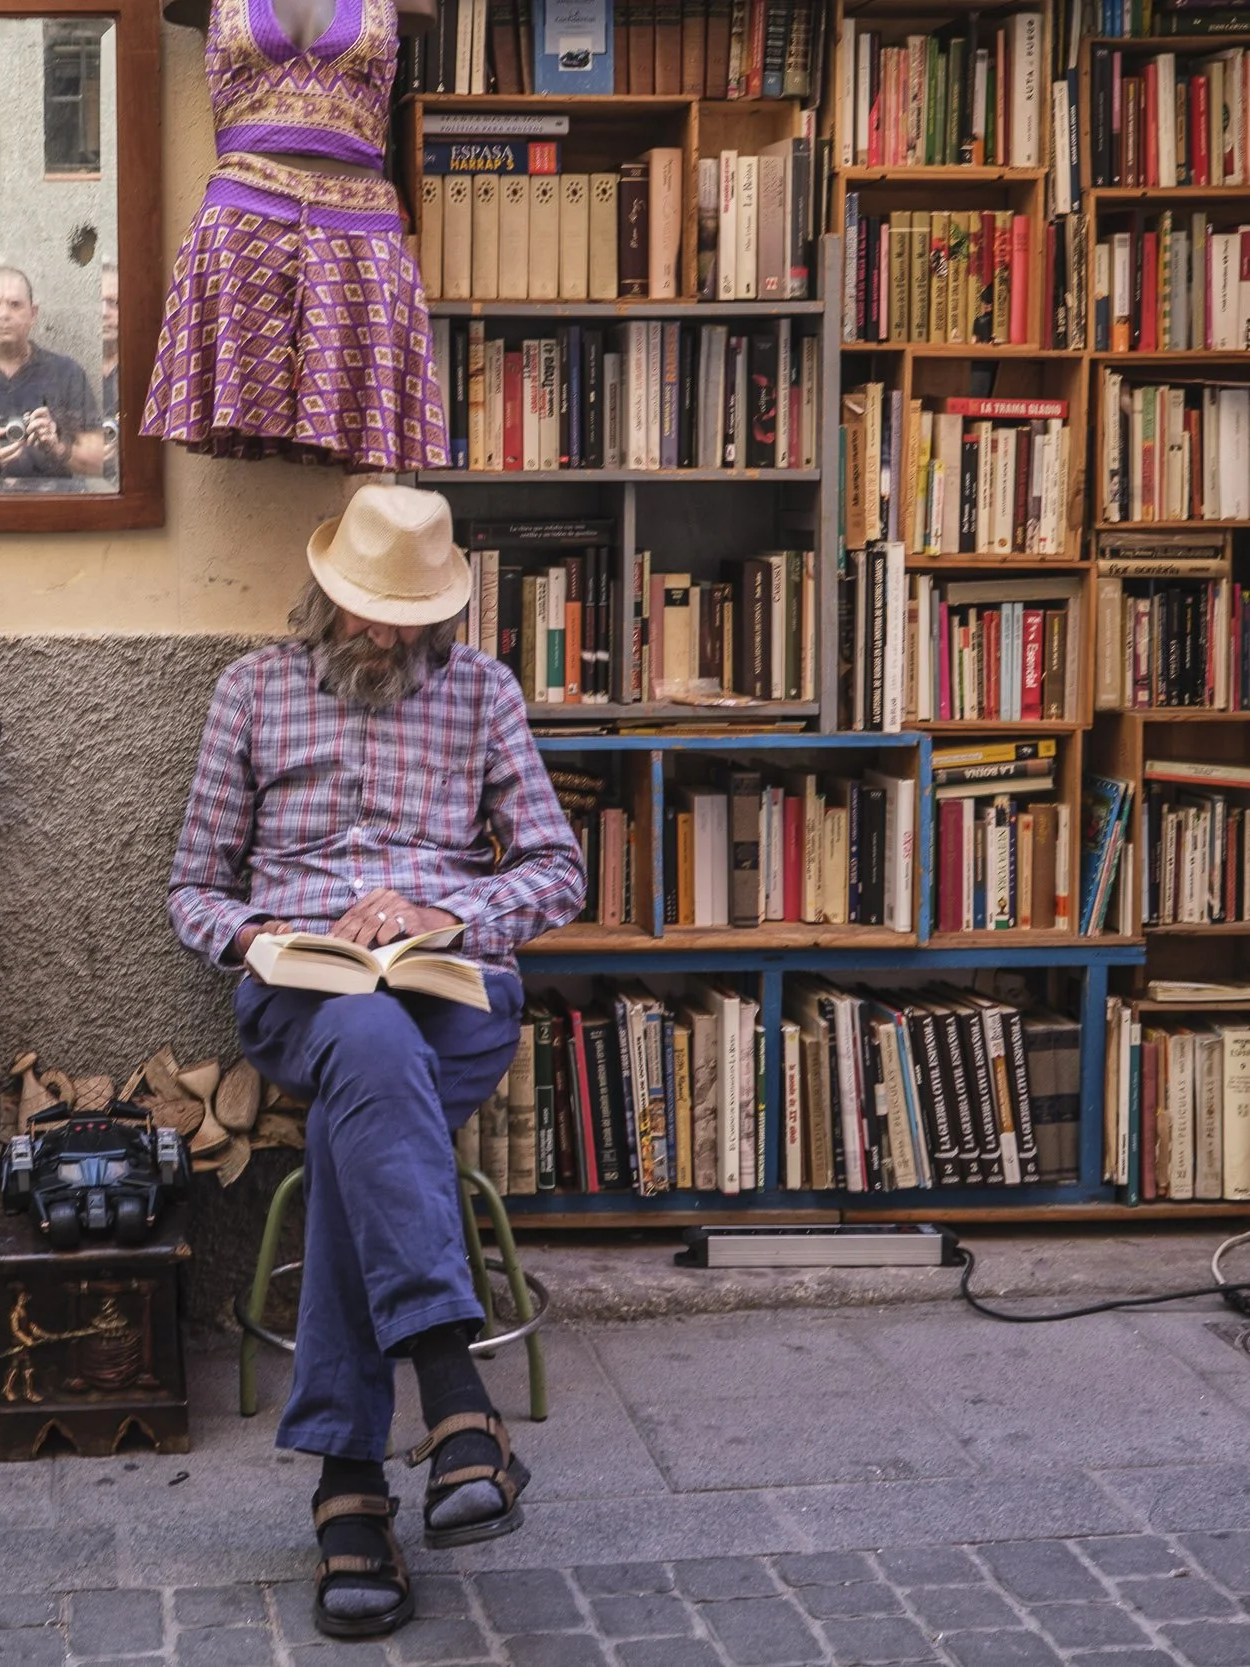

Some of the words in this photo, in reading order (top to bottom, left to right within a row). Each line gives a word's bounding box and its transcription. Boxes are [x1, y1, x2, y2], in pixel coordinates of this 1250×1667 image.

[450, 159, 515, 171] HARRAP'S
[451, 145, 515, 161] ESPASA
[980, 401, 993, 415] LA
[994, 402, 1027, 415] TRAMA
[922, 1015, 940, 1068] ESPAÑOLA
[945, 1015, 963, 1068] ESPAÑOLA
[969, 1015, 986, 1068] ESPAÑOLA
[1009, 1015, 1025, 1068] ESPAÑOLA
[929, 1066, 943, 1095] CIVIL
[953, 1066, 967, 1095] CIVIL
[976, 1066, 989, 1095] CIVIL
[1014, 1066, 1028, 1095] CIVIL
[933, 1094, 949, 1135] GUERRA
[958, 1094, 973, 1135] GUERRA
[980, 1094, 995, 1135] GUERRA
[1018, 1094, 1032, 1135] GUERRA
[939, 1134, 952, 1149] LA
[963, 1134, 976, 1149] LA
[985, 1134, 997, 1149] LA
[1022, 1134, 1034, 1149] LA
[944, 1162, 954, 1175] 2
[969, 1162, 979, 1175] 3
[990, 1162, 1000, 1175] 4
[1026, 1162, 1037, 1175] 6
